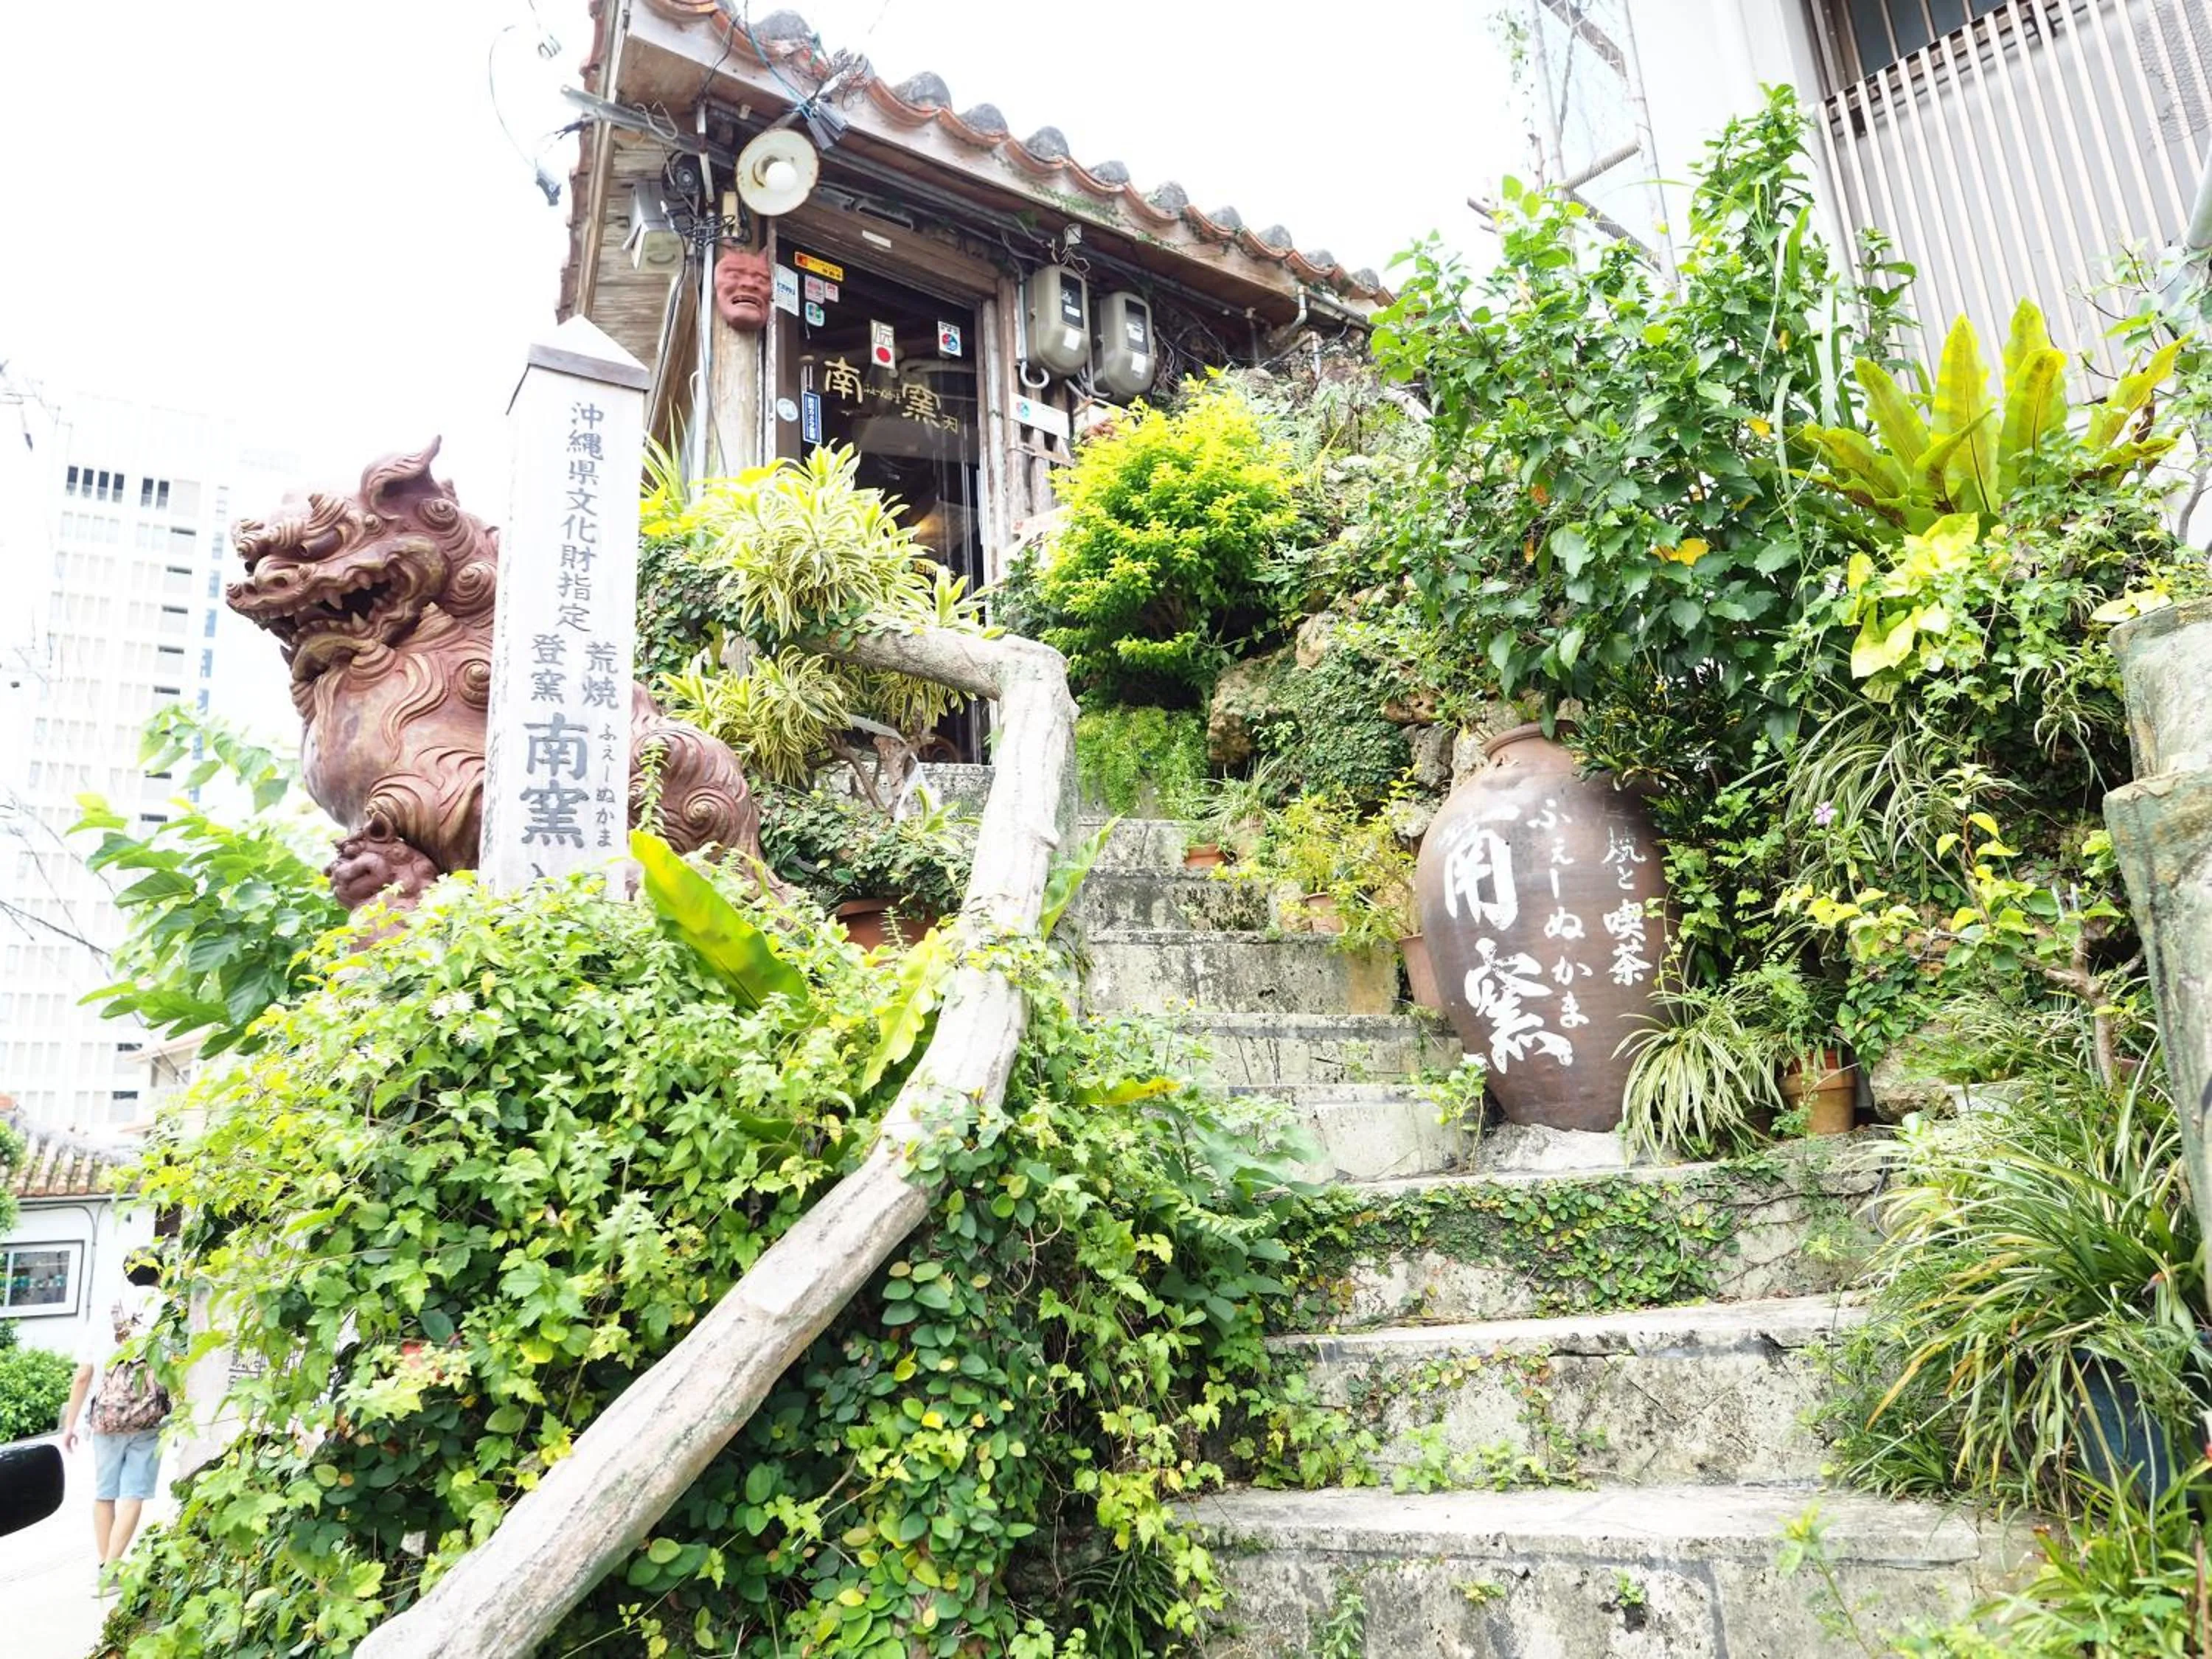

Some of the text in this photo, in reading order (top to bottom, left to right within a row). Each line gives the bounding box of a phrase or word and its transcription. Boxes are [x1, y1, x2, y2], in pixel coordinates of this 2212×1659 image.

[824, 357, 863, 403] 南
[555, 402, 605, 633] 沖縄県文化財指定
[530, 634, 567, 704] 登窯
[581, 641, 620, 709] 荒焼
[519, 712, 591, 849] 南窯
